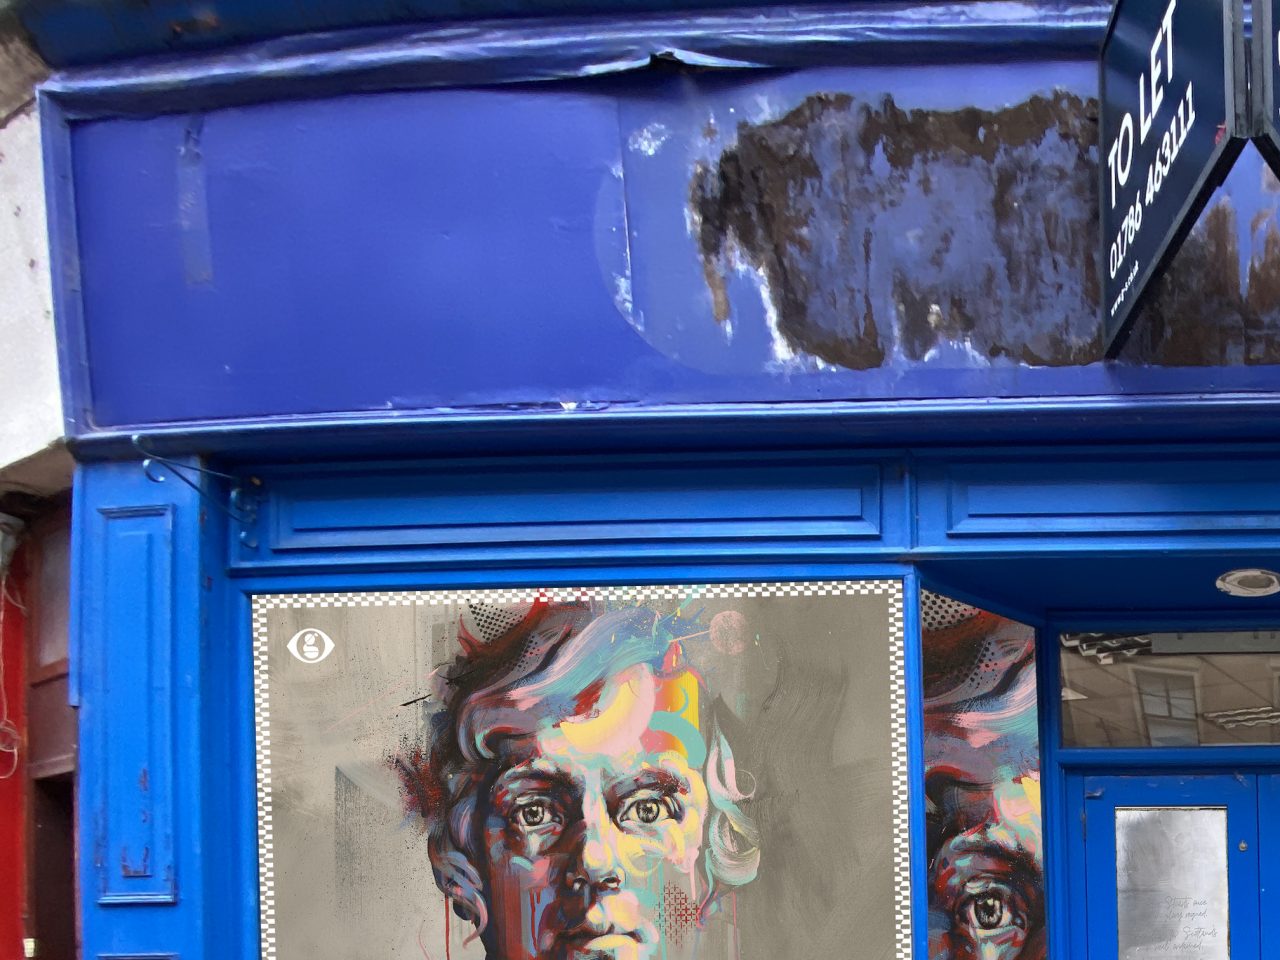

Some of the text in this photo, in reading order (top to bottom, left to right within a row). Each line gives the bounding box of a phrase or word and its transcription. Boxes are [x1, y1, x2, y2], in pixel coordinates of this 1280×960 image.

[1108, 0, 1176, 210] TO LET
[1110, 81, 1196, 280] 01786 463111
